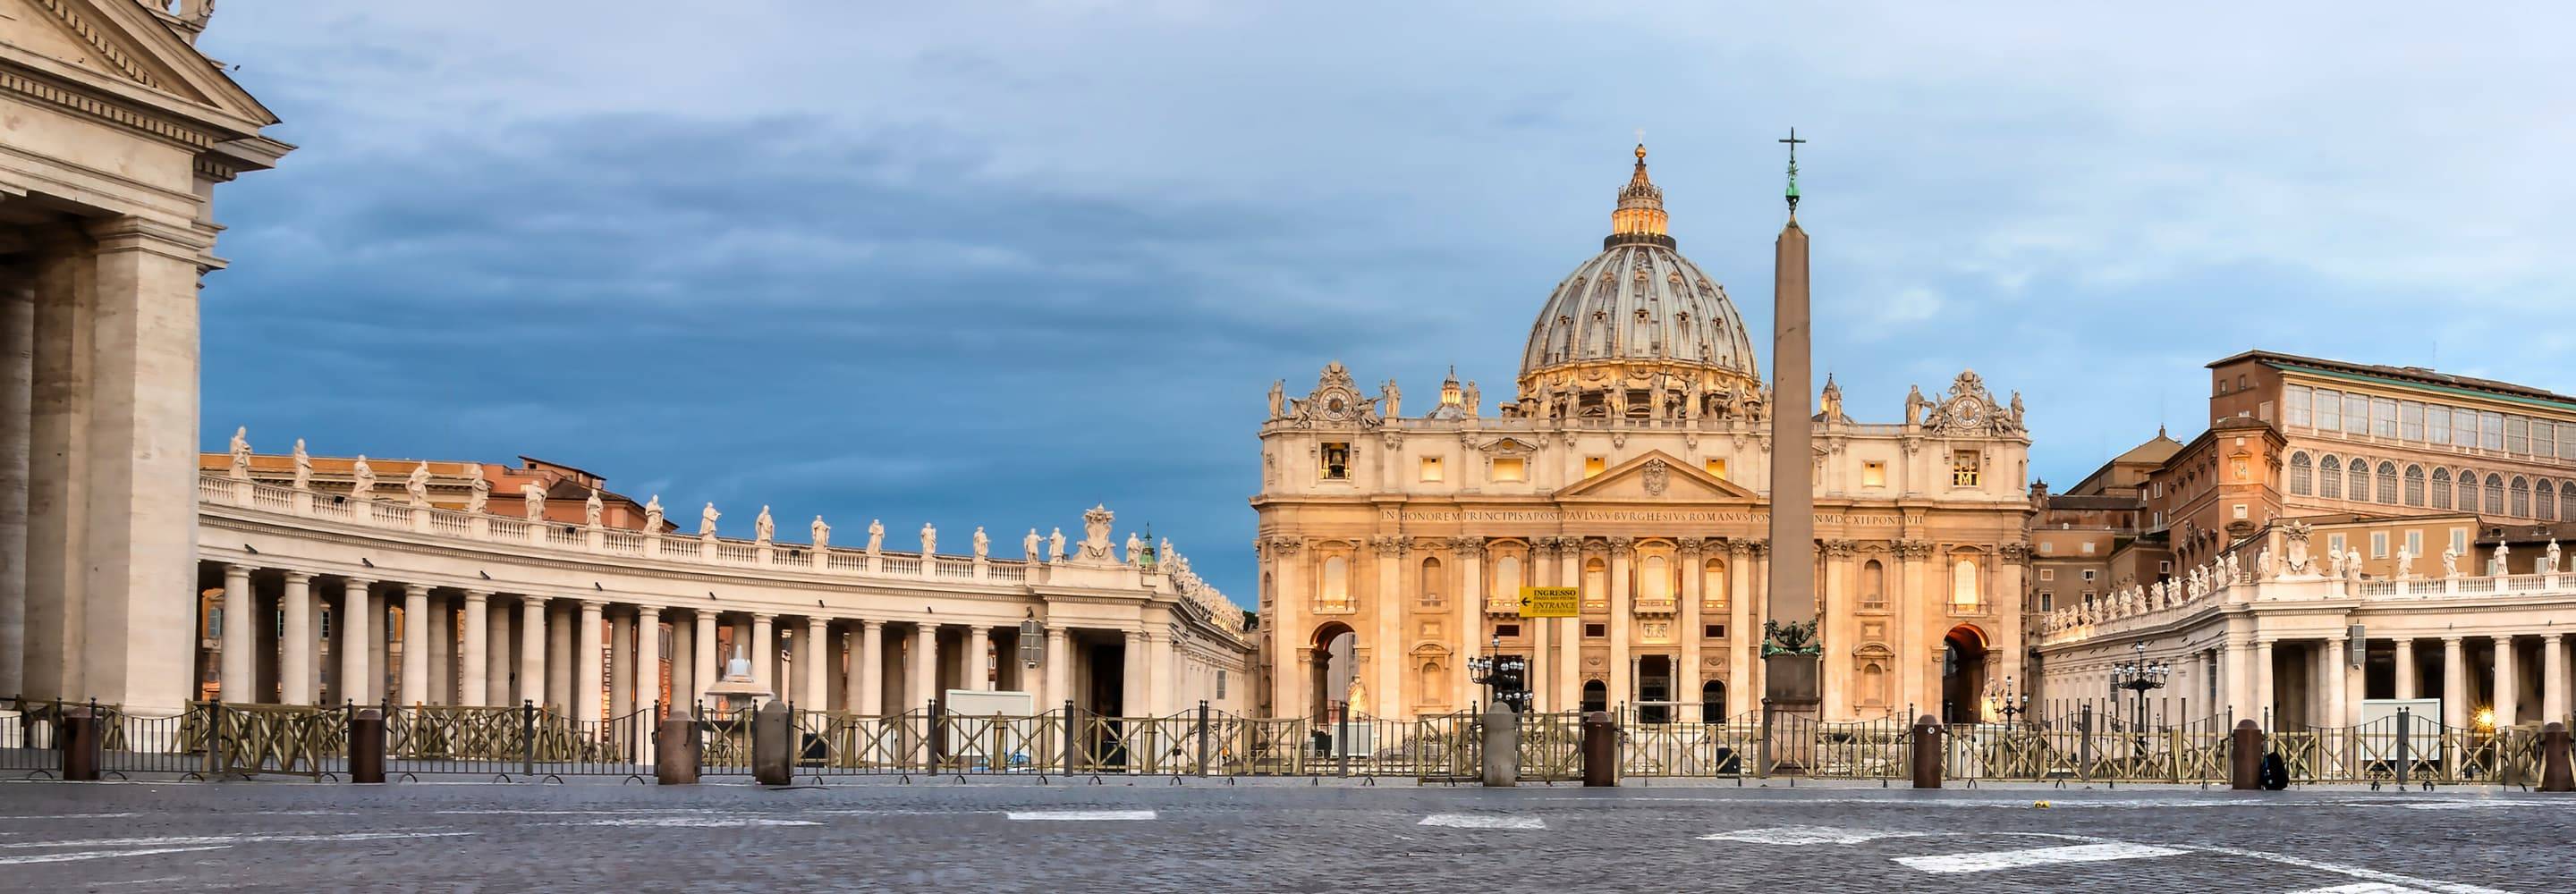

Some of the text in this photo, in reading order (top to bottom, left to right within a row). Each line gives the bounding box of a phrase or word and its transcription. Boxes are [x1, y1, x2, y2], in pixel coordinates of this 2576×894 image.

[1381, 510, 1394, 520] IN
[1400, 511, 1461, 521] HONOREM
[1463, 511, 1523, 521] PRINCIPIS
[1525, 511, 1561, 521] APOST
